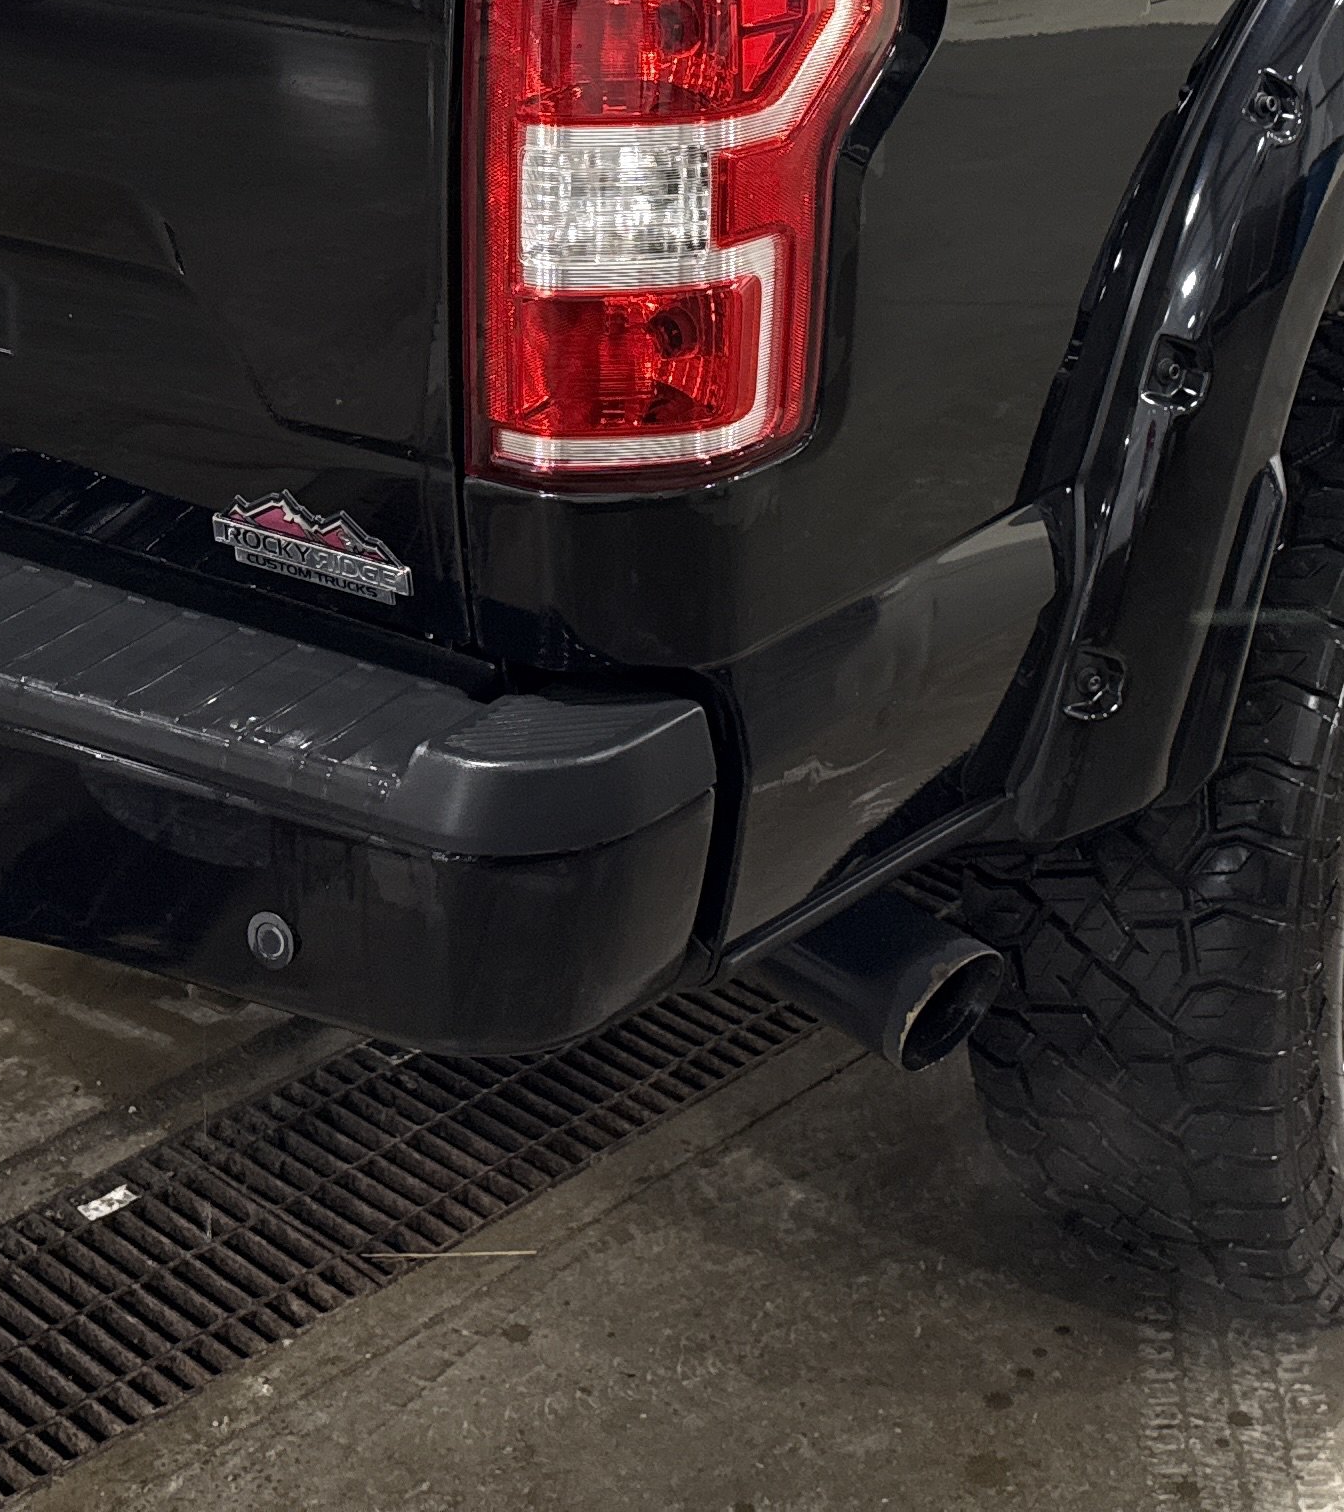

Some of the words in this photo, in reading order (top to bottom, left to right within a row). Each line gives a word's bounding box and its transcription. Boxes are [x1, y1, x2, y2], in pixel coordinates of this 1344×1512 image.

[224, 525, 311, 563] ROCKY
[247, 554, 312, 580] CUSTOM
[315, 571, 378, 598] TRUCKS
